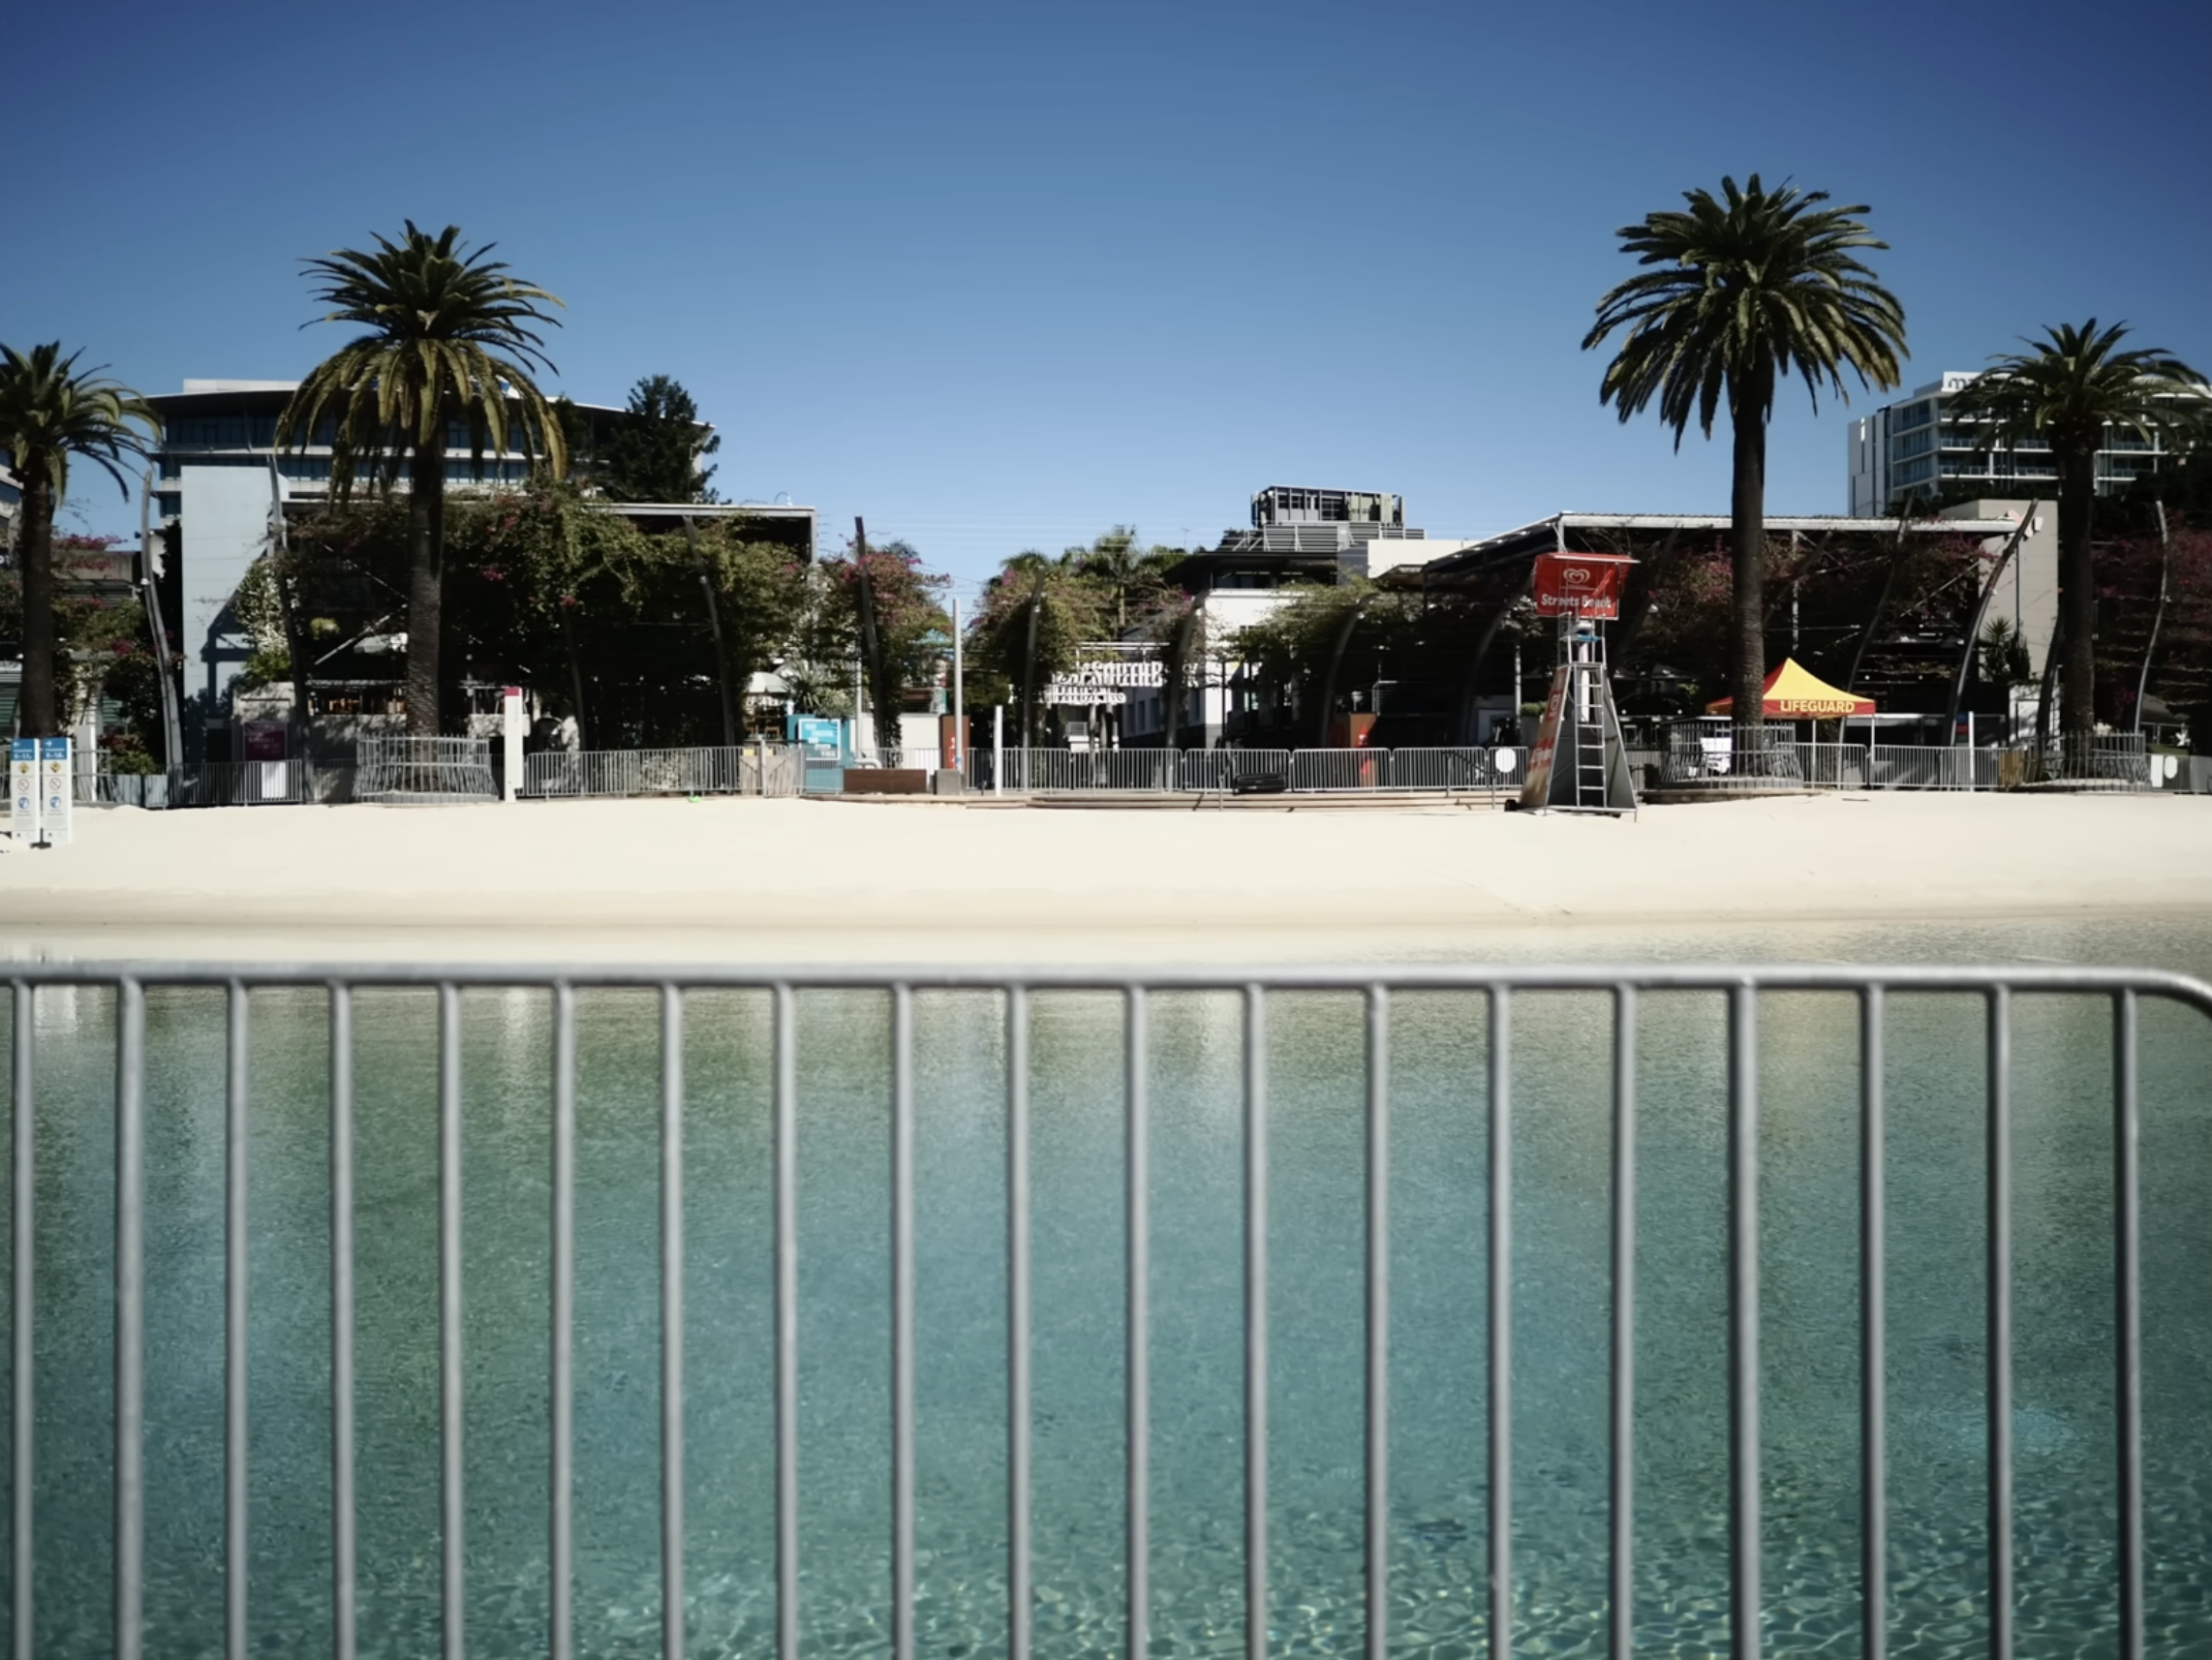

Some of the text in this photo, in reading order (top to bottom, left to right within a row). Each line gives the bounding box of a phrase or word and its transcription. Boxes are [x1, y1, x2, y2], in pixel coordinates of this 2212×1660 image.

[1541, 593, 1612, 608] Streets Beach
[1780, 699, 1856, 714] LIFEGUARD
